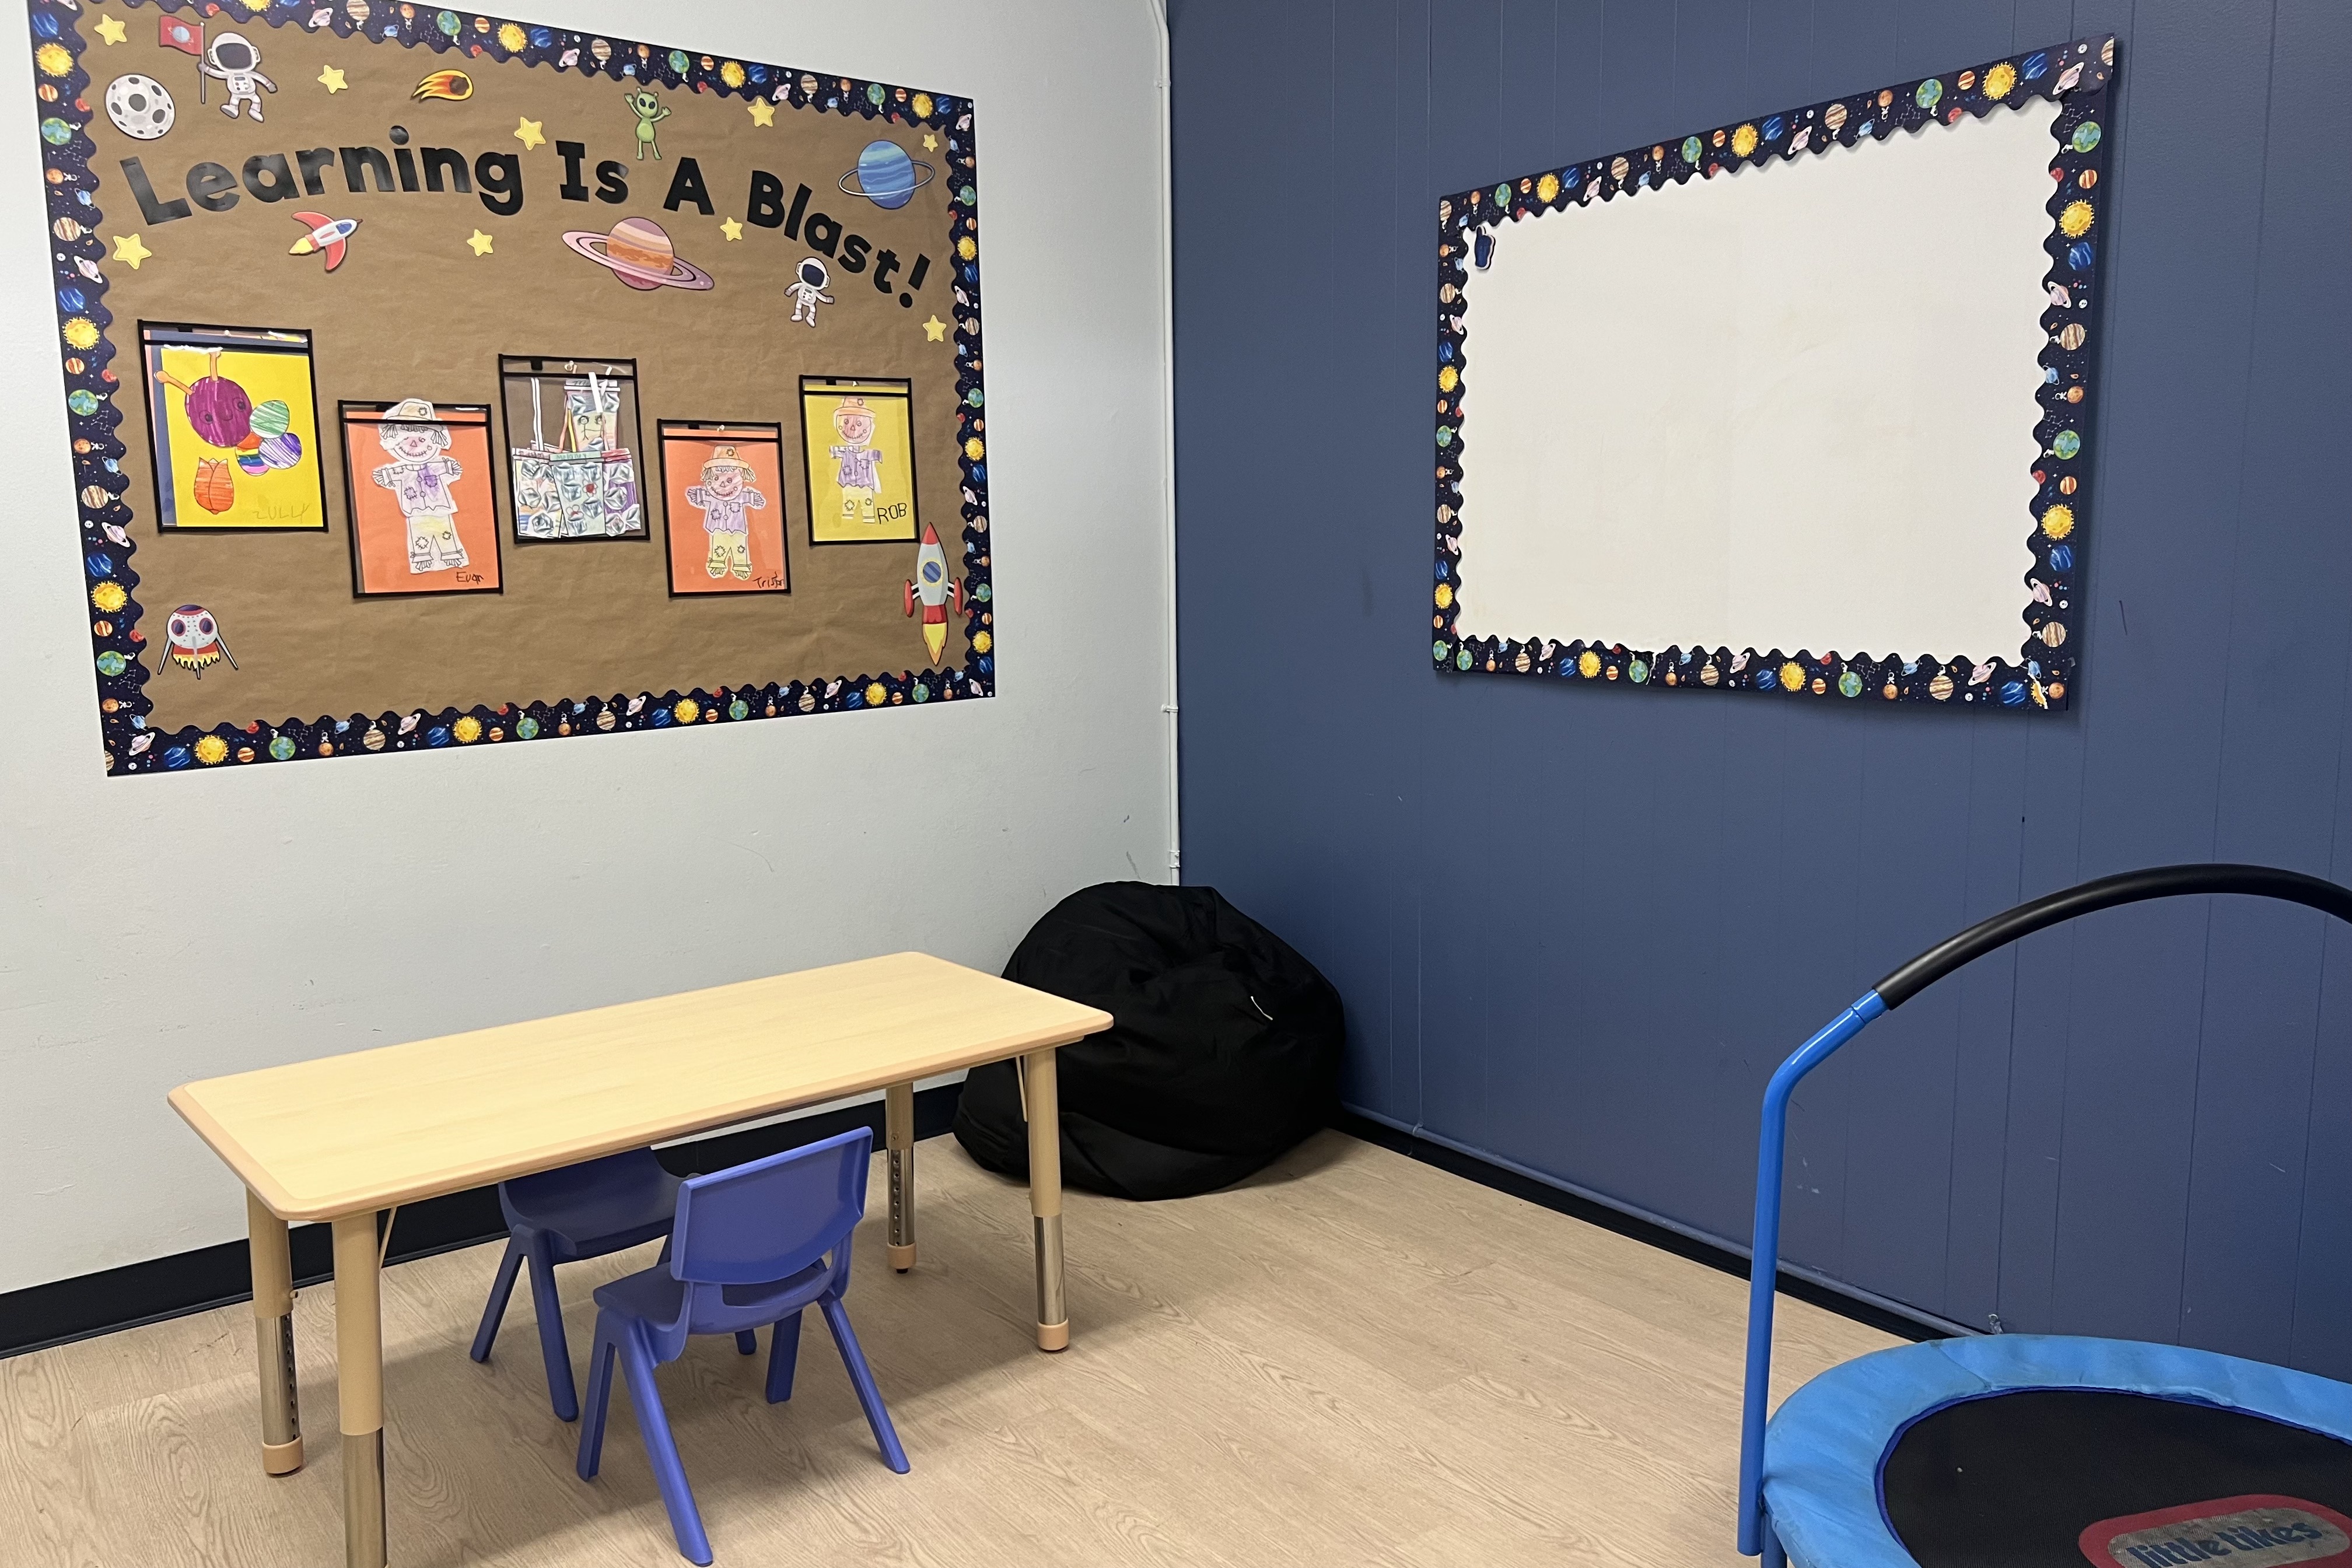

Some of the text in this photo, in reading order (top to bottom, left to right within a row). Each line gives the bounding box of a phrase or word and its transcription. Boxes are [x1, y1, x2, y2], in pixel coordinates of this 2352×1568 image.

[120, 125, 931, 309] Learning Is A Blast!
[877, 502, 907, 524] ROB
[2126, 1522, 2323, 1568] little tikes
